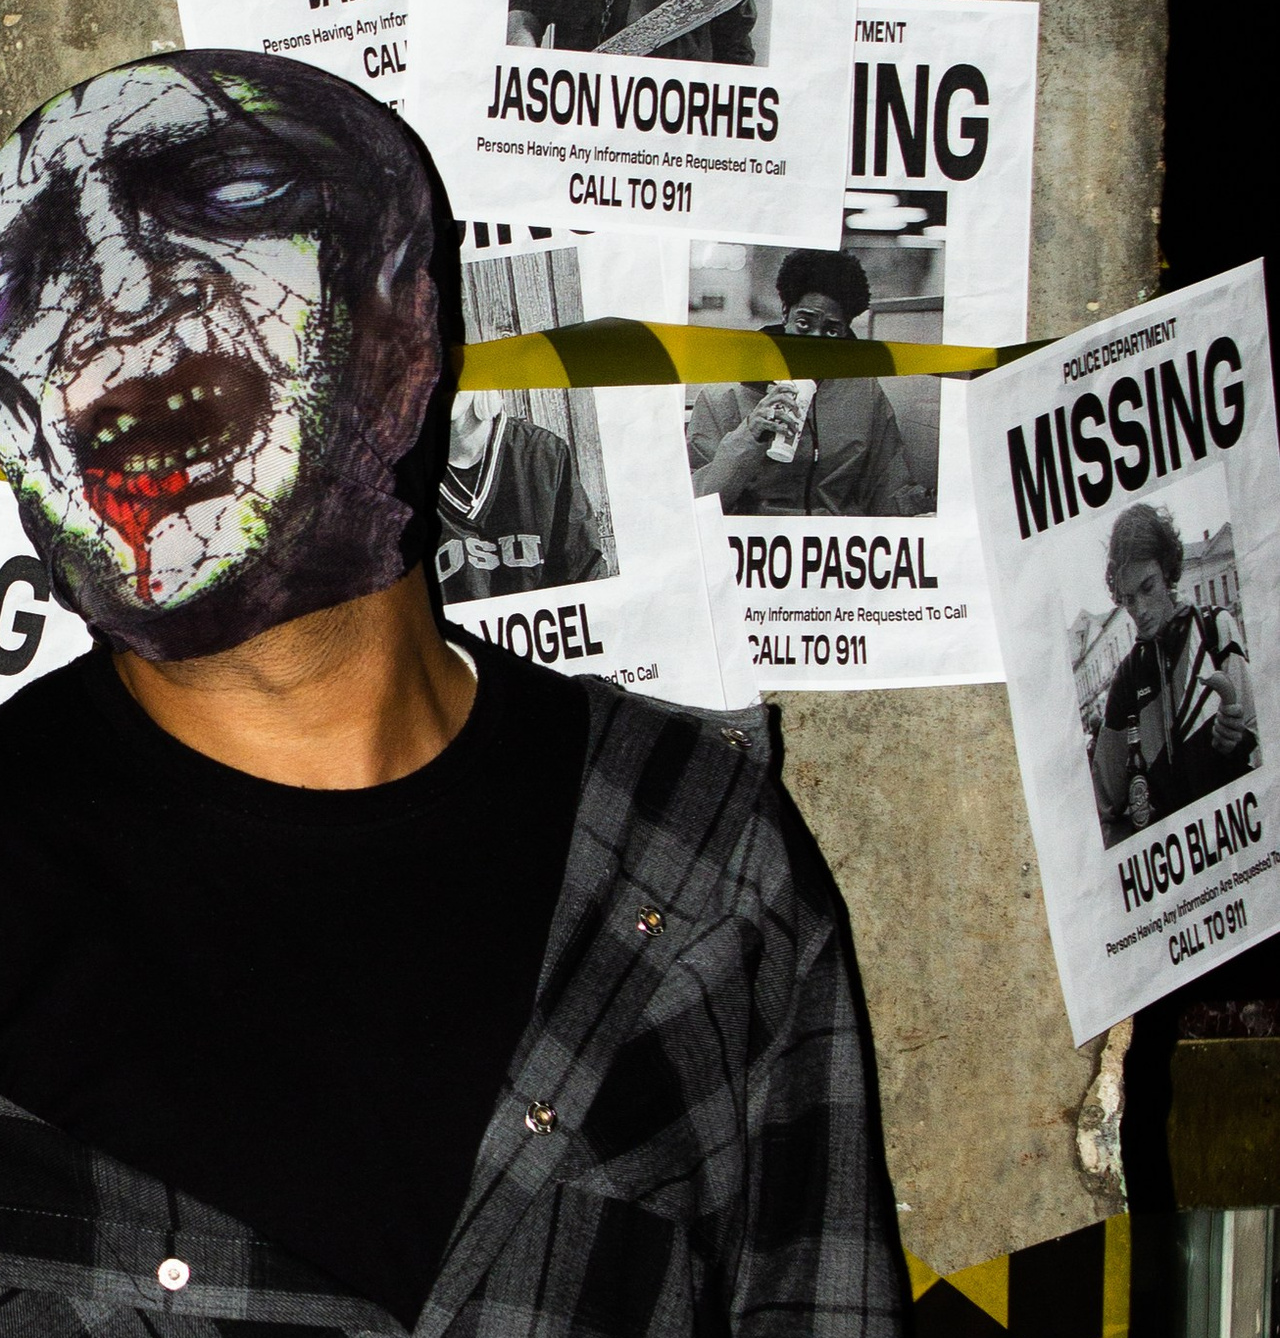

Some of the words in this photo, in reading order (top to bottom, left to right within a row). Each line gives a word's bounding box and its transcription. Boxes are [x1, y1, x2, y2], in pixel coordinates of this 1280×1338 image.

[262, 33, 312, 54] Persons
[312, 24, 354, 44] Having
[356, 19, 378, 36] Any
[363, 40, 407, 79] CAL
[487, 64, 602, 127] JASON
[610, 74, 780, 142] VOORHES
[477, 136, 525, 155] Persons
[526, 140, 567, 162] Having
[568, 144, 592, 164] Any
[594, 146, 660, 166] Information
[661, 151, 683, 168] Are
[685, 153, 747, 174] Requested
[749, 158, 763, 174] To
[765, 159, 787, 176] Call
[569, 172, 623, 207] CALL
[627, 177, 658, 210] TO
[662, 179, 692, 213] 911
[1063, 348, 1101, 384] POLICE
[1102, 317, 1177, 367] DEPARTMENT
[1006, 336, 1245, 539] MISSING
[801, 535, 938, 590] PASCAL
[480, 603, 604, 664] VOGEL
[744, 607, 767, 626] Any
[768, 606, 832, 622] Information
[833, 607, 855, 622] Are
[857, 606, 923, 625] Requested
[925, 606, 941, 620] To
[944, 604, 967, 620] Call
[620, 669, 635, 684] To
[637, 663, 659, 680] Call
[801, 634, 831, 666] TO
[835, 634, 867, 665] 911
[1118, 833, 1185, 912] HUGO
[1184, 792, 1262, 875] BLANC
[1169, 924, 1205, 965] CALL
[1203, 911, 1225, 945] TO
[1225, 898, 1248, 934] 911
